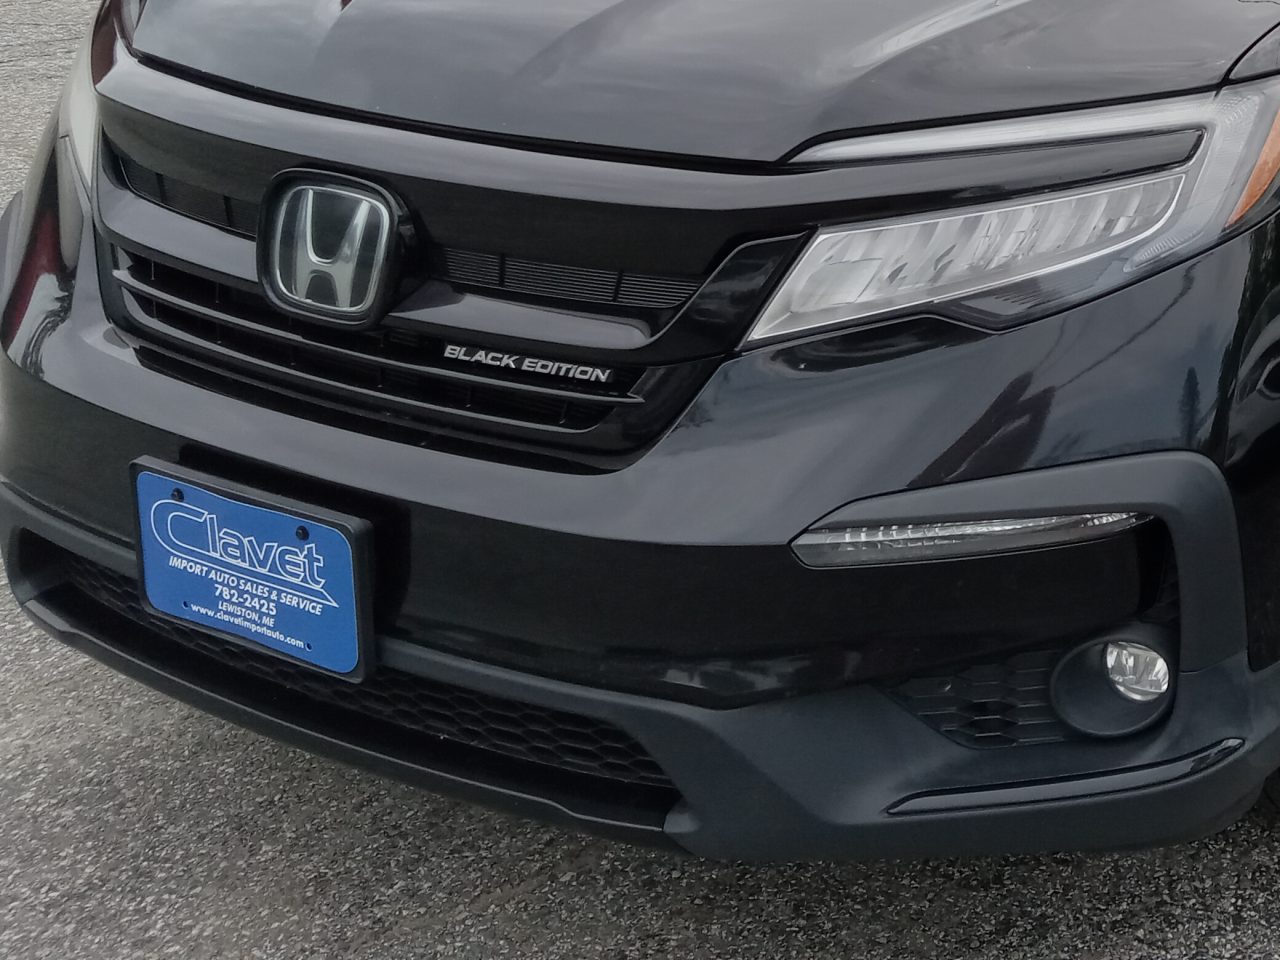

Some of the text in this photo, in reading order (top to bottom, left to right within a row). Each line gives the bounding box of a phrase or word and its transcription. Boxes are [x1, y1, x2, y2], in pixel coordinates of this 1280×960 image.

[443, 344, 612, 383] BLACK EDITION
[150, 499, 327, 590] Clavet
[168, 555, 323, 616] IMPORT AUTO SALES & SERVICE
[214, 584, 277, 616] 782-2425
[190, 603, 305, 649] www.clavetimportauto.com
[218, 600, 275, 628] LEWISTON, ME
